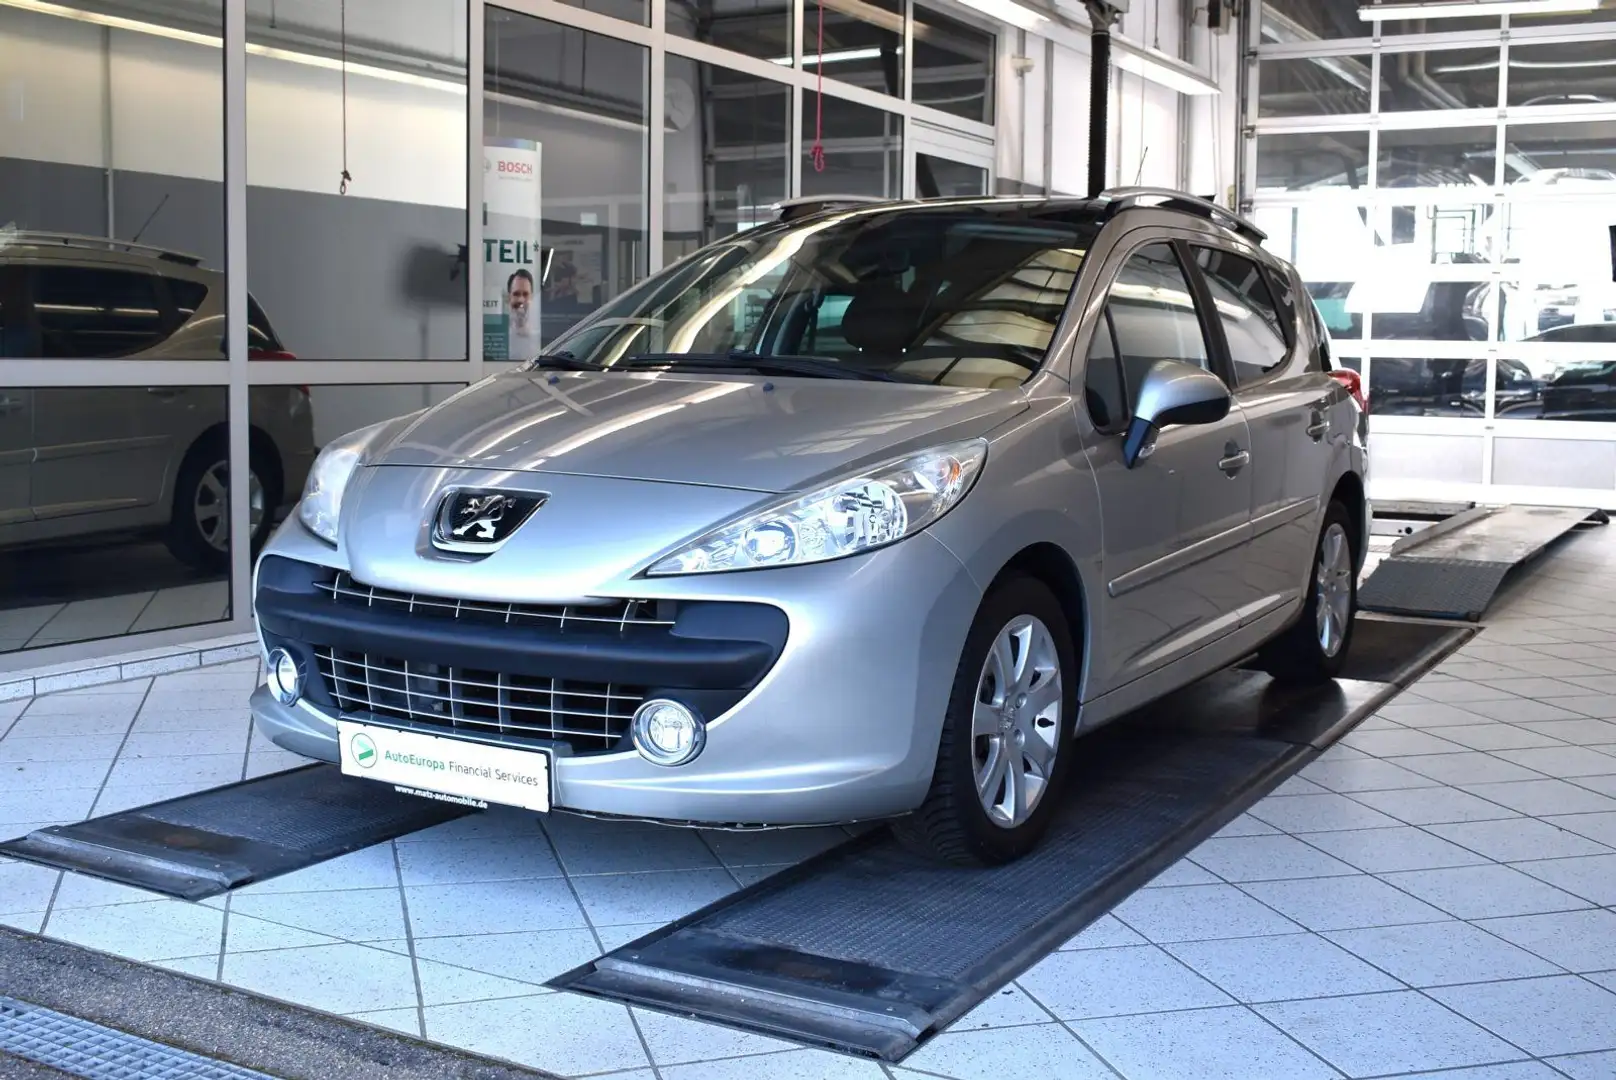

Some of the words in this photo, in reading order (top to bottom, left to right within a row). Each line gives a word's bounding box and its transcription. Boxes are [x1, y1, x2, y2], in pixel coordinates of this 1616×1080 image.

[498, 160, 533, 174] BOSCH
[384, 750, 445, 771] AutoEuropa
[449, 761, 492, 779] Financial
[495, 768, 538, 786] Services
[394, 785, 488, 809] www.matz-automobile.de
